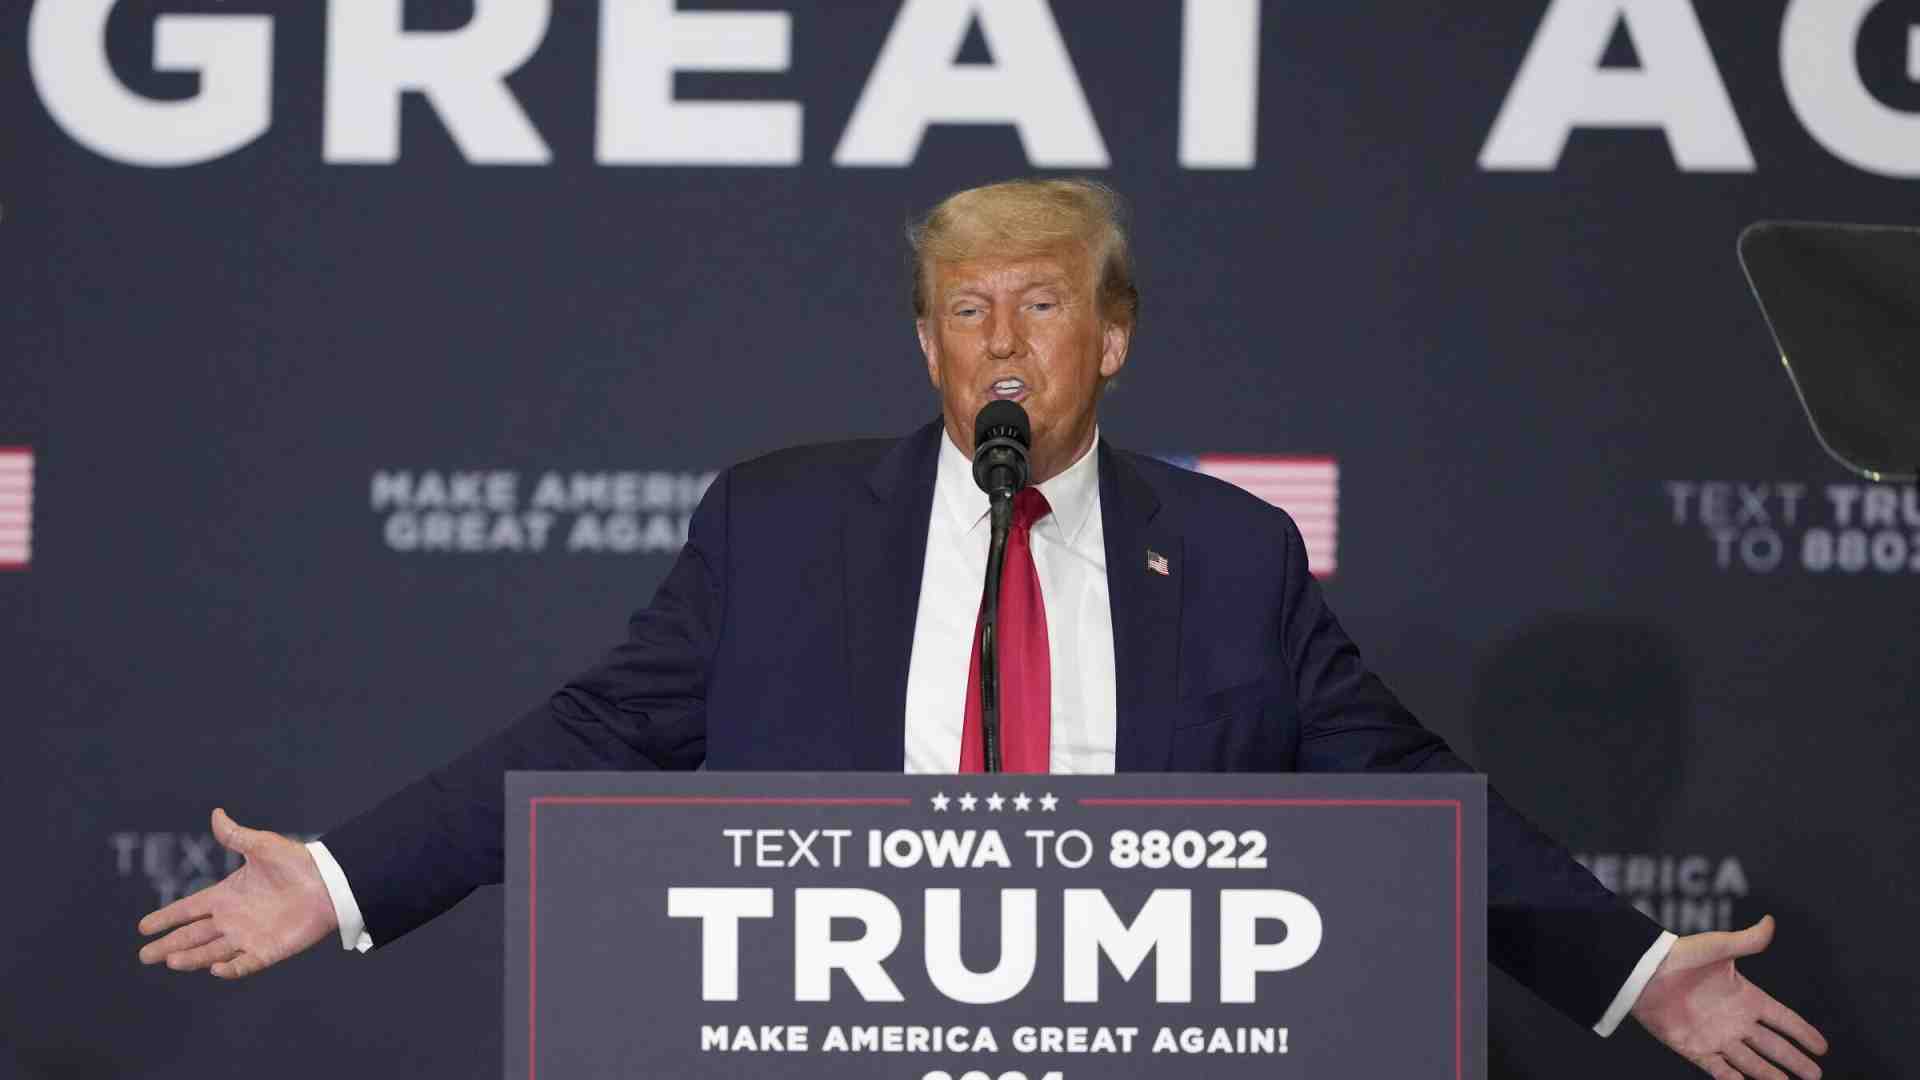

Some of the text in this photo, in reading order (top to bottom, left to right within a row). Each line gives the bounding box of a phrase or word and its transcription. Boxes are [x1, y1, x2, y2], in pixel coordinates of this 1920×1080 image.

[370, 470, 518, 512] MAKE
[1667, 482, 1806, 526] TEXT
[385, 512, 554, 552] GREAT
[1710, 527, 1782, 572] TO
[110, 832, 244, 875] TEX
[722, 828, 1268, 869] TEXT IOWA TO 88022
[1572, 854, 1748, 896] ERICA
[667, 887, 1323, 1005] TRUMP
[701, 1025, 1289, 1054] MAKE AMERICA GREAT AGAIN!
